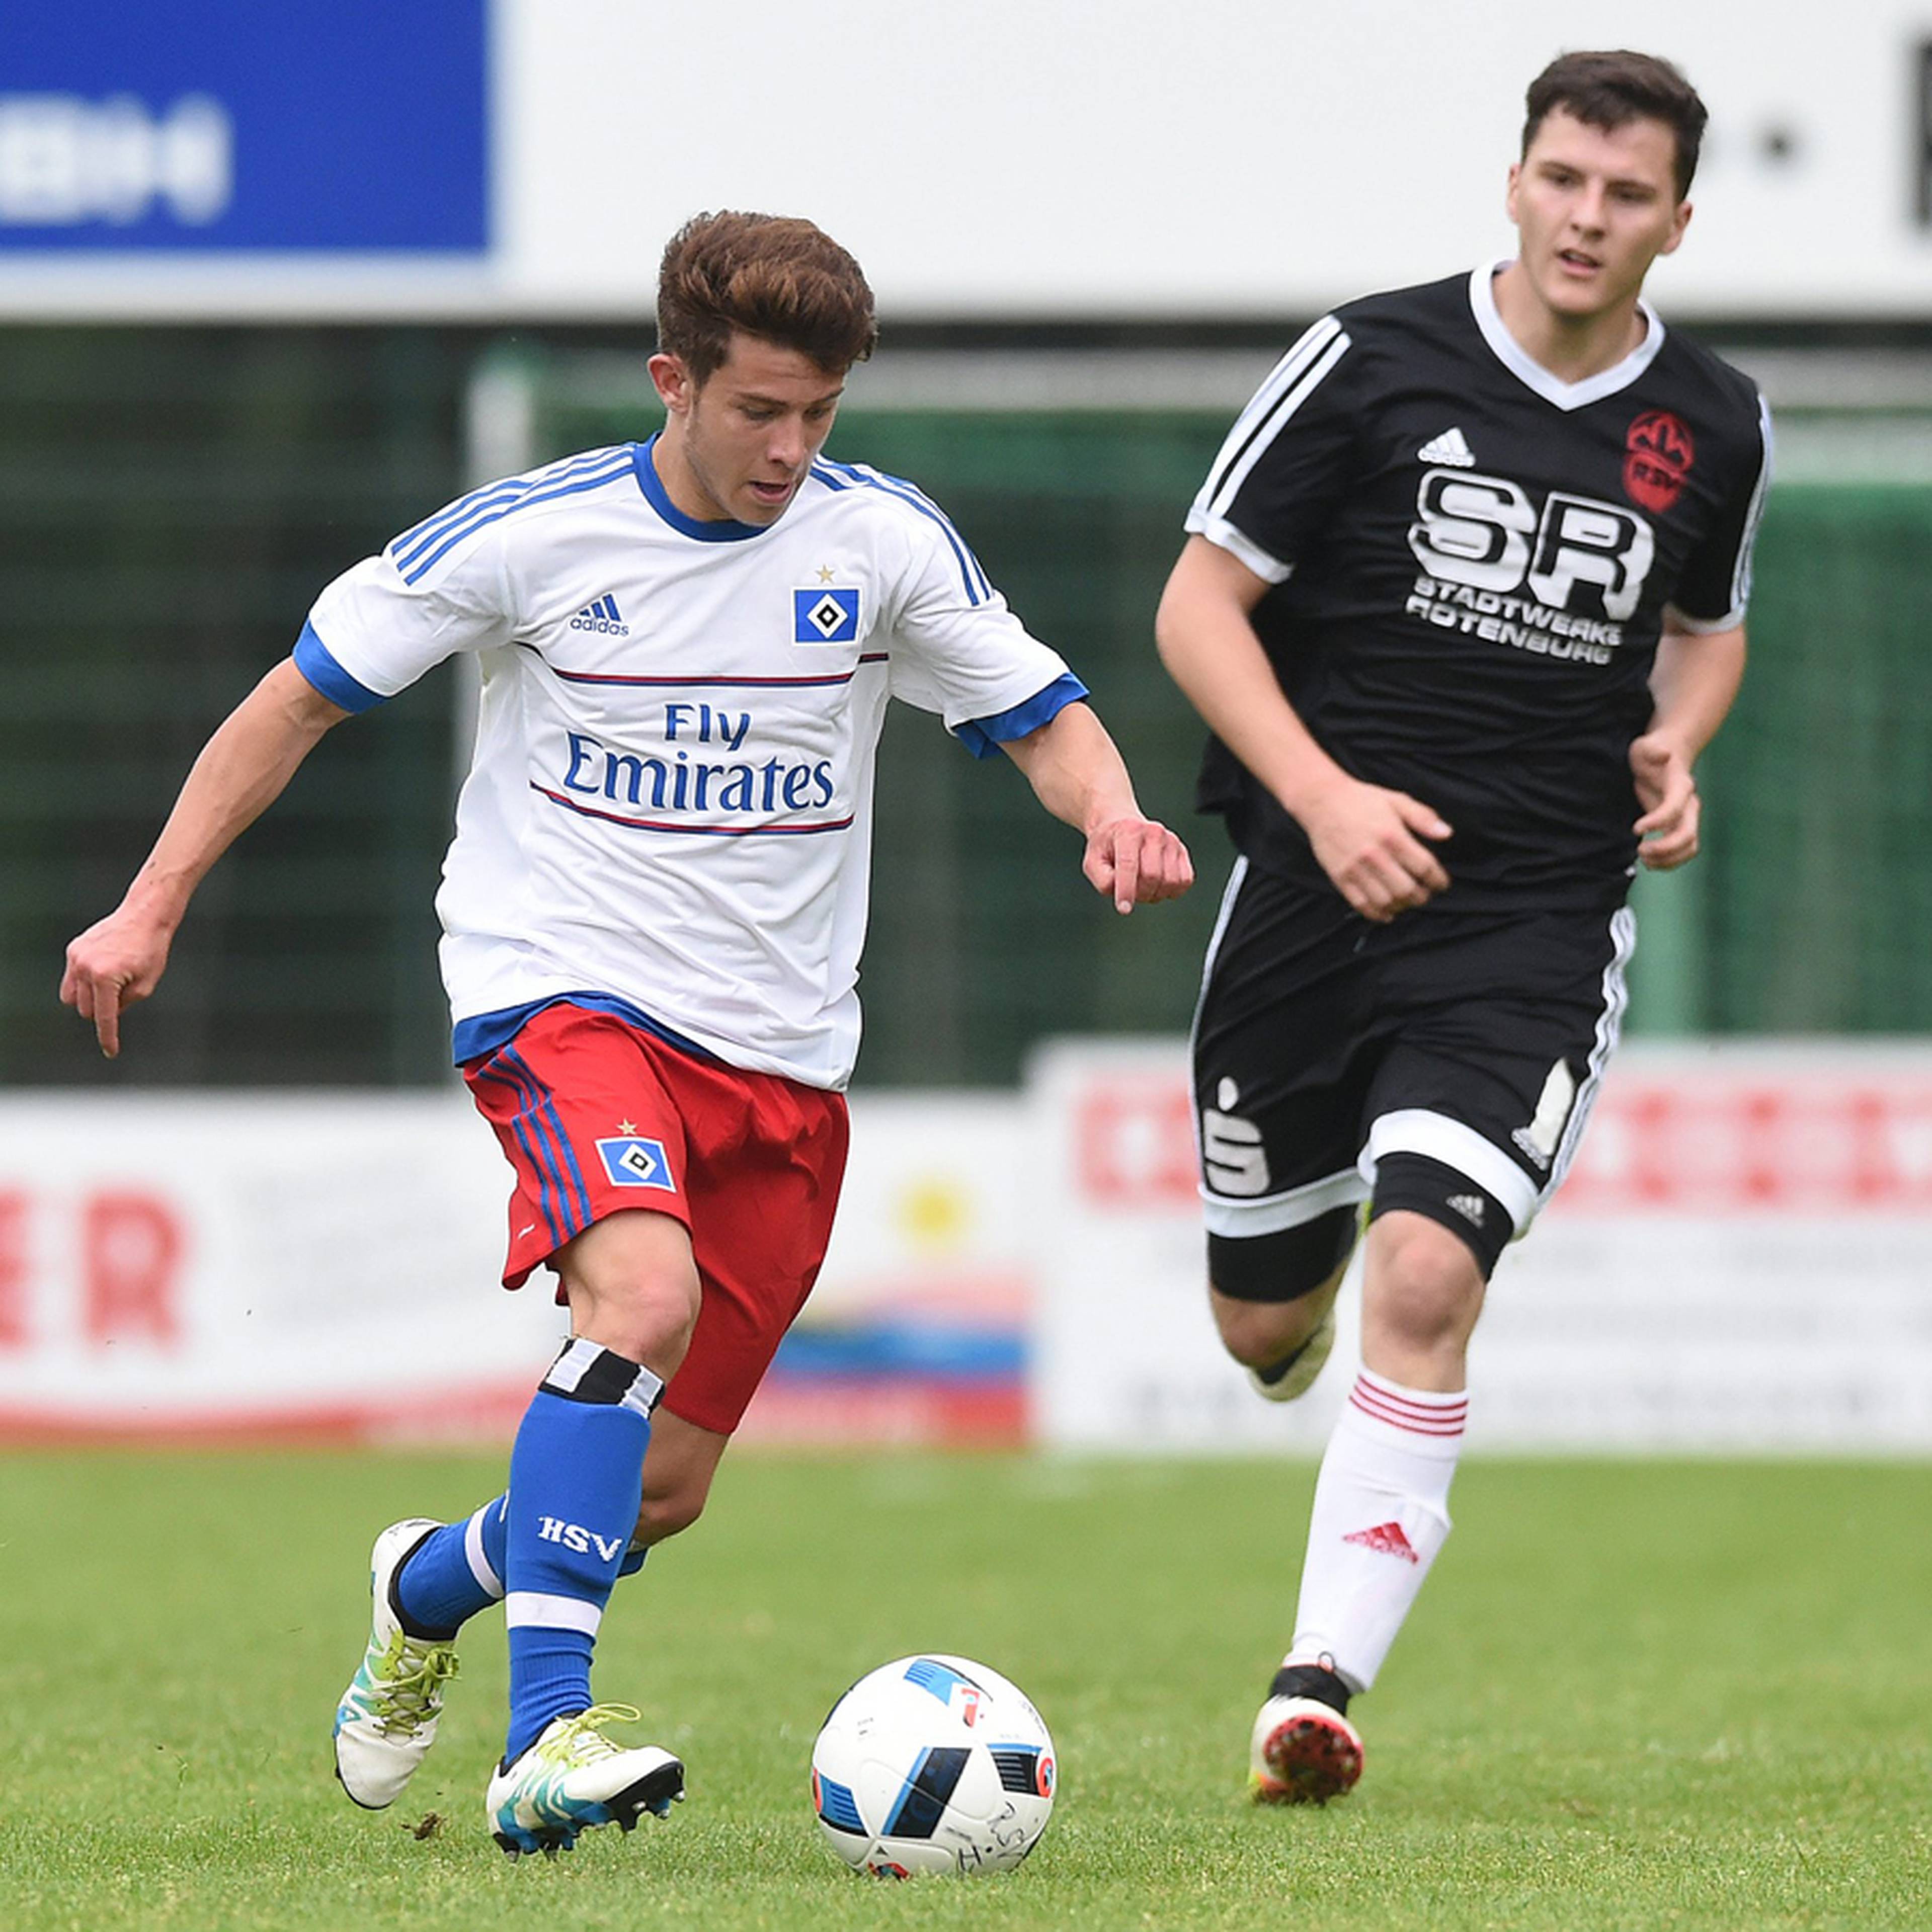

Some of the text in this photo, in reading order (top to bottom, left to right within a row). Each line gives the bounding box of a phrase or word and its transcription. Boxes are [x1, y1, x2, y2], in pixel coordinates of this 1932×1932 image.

[1407, 467, 1654, 621] SR
[570, 616, 629, 637] adidas
[1405, 595, 1612, 665] ROTENBURG
[1413, 576, 1623, 647] STADTWERKE
[664, 704, 751, 751] Fly
[564, 731, 834, 812] Emirates
[537, 1516, 623, 1562] HSV
